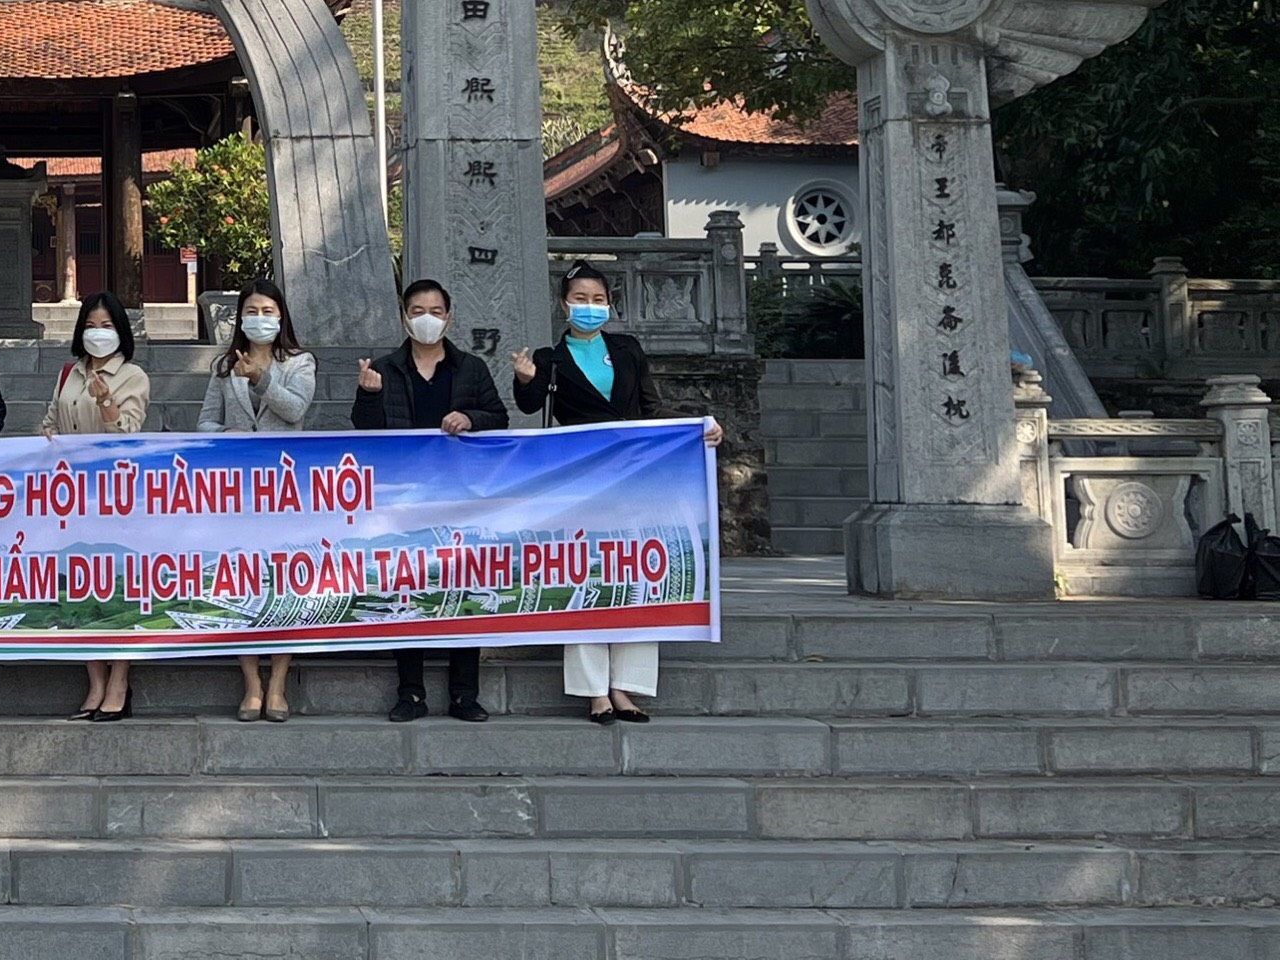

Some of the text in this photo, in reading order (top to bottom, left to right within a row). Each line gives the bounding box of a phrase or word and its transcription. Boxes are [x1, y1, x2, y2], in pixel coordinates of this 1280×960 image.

[27, 461, 85, 529] HỘI
[99, 461, 137, 515] LỮ
[147, 455, 241, 514] HÀNH
[254, 452, 301, 512] HÀ
[313, 454, 373, 524] NỘI
[68, 555, 114, 601] DU
[127, 553, 200, 614] LỊCH
[214, 549, 260, 598] AN
[271, 538, 364, 596] TOÀN
[375, 548, 426, 604] TẠI
[437, 532, 511, 590] TỈNH
[523, 529, 587, 587] PHÚ
[599, 538, 668, 595] THỌ
